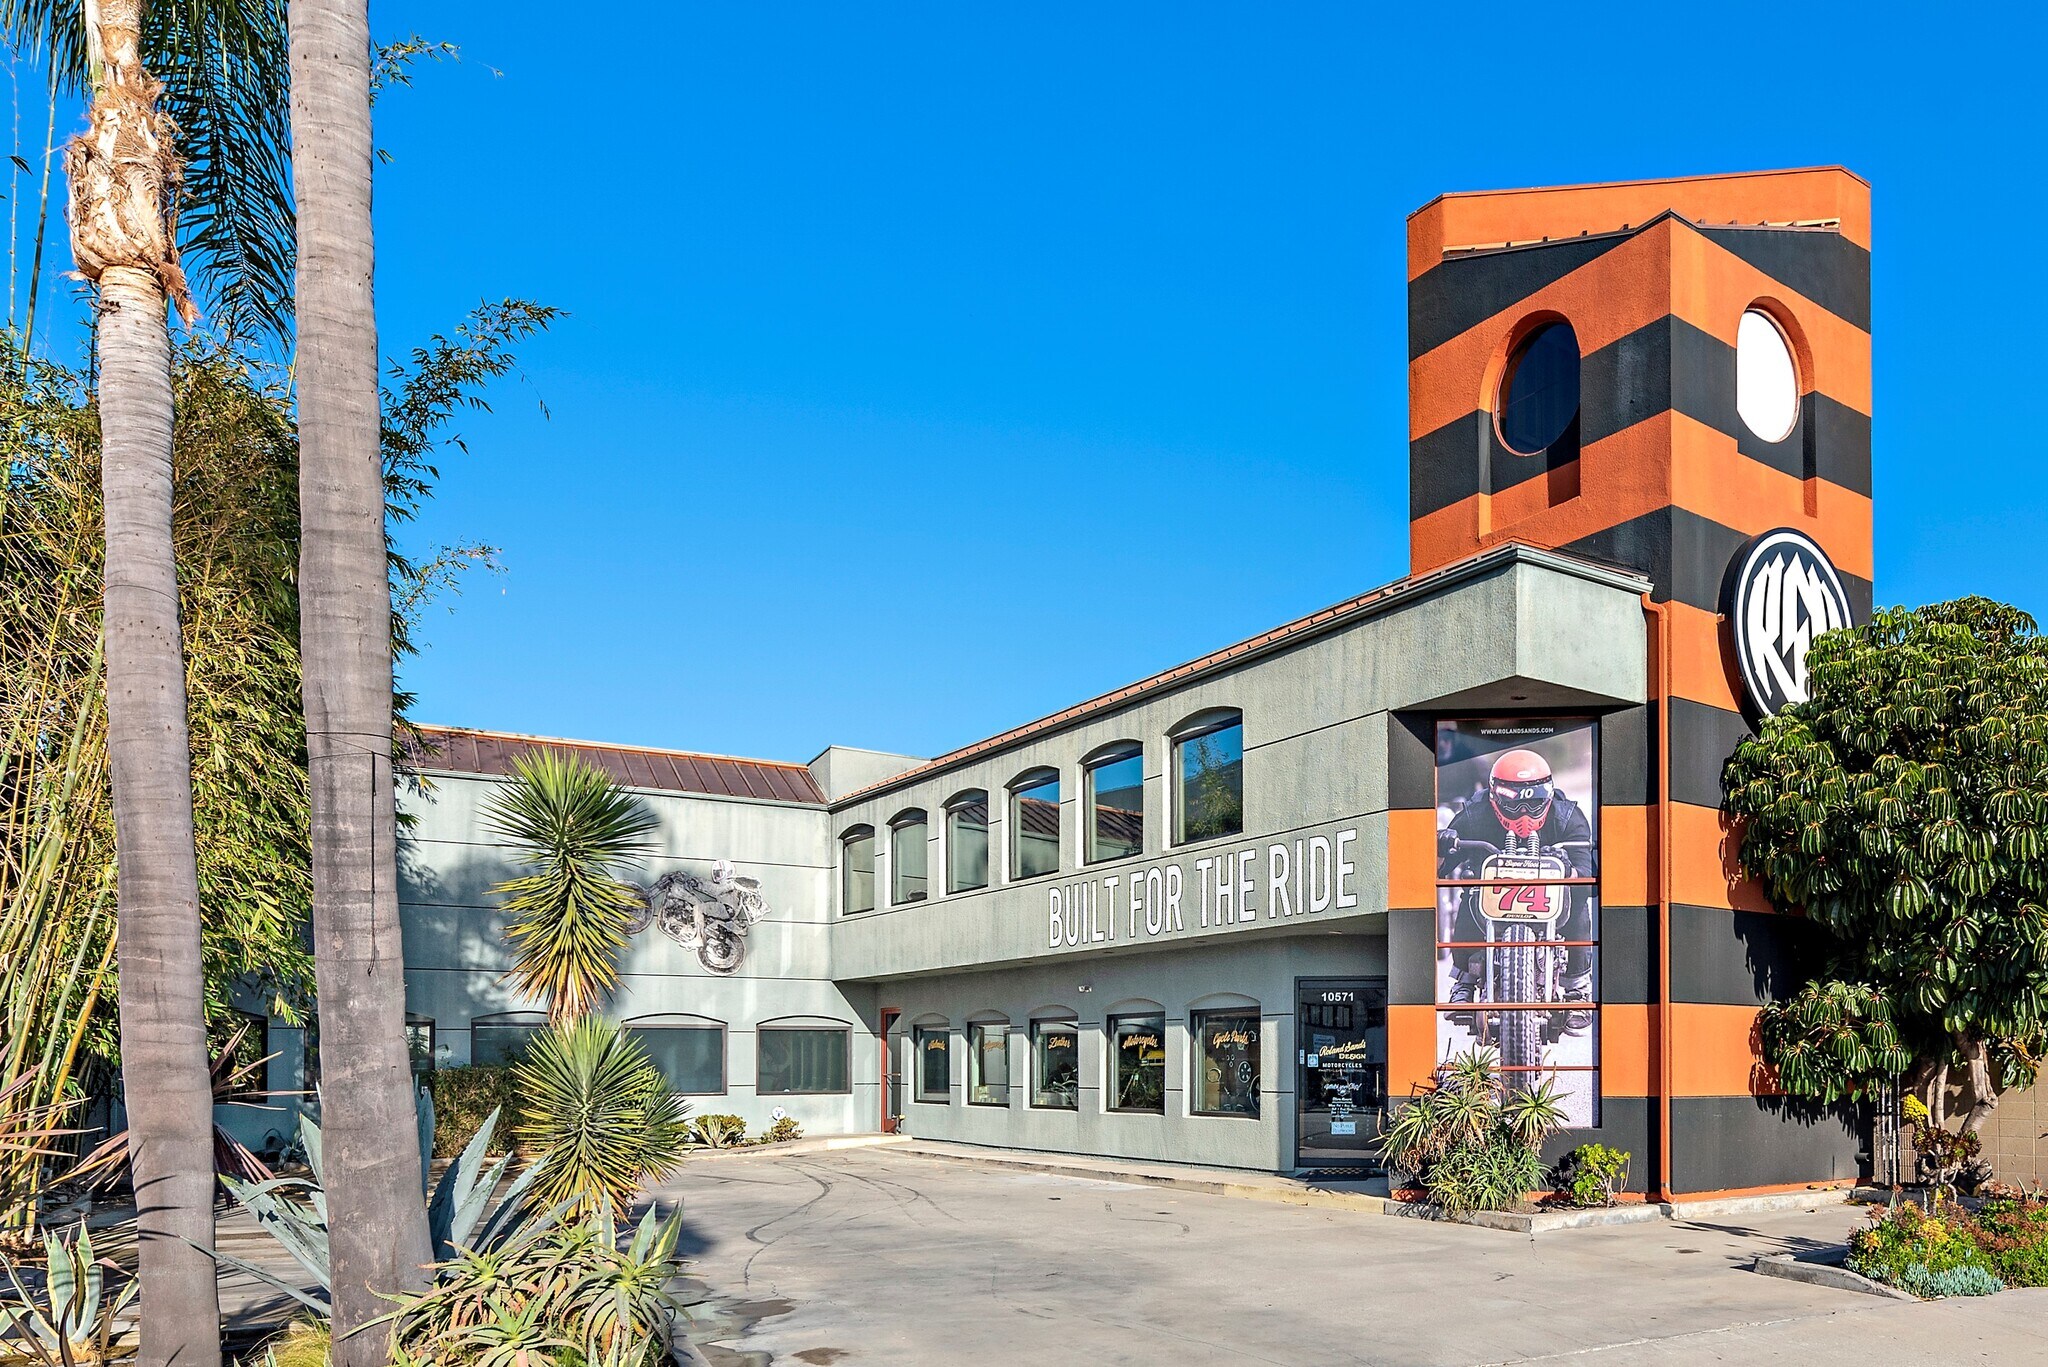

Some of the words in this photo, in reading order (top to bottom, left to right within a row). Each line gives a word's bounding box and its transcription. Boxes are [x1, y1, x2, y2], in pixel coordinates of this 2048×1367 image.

[1480, 727, 1554, 735] WWW.ROLANDSANDS.COM
[1520, 788, 1534, 799] 10
[1049, 875, 1119, 948] BUILT
[1129, 864, 1183, 938] FOR
[1196, 849, 1256, 928] THE
[1267, 828, 1357, 919] RIDE
[1493, 877, 1550, 912] 74
[1321, 992, 1354, 1001] 10571
[1213, 1031, 1231, 1049] Cycle
[1230, 1030, 1249, 1045] Parts
[1319, 1043, 1345, 1057] Roland
[1344, 1039, 1366, 1053] Sands
